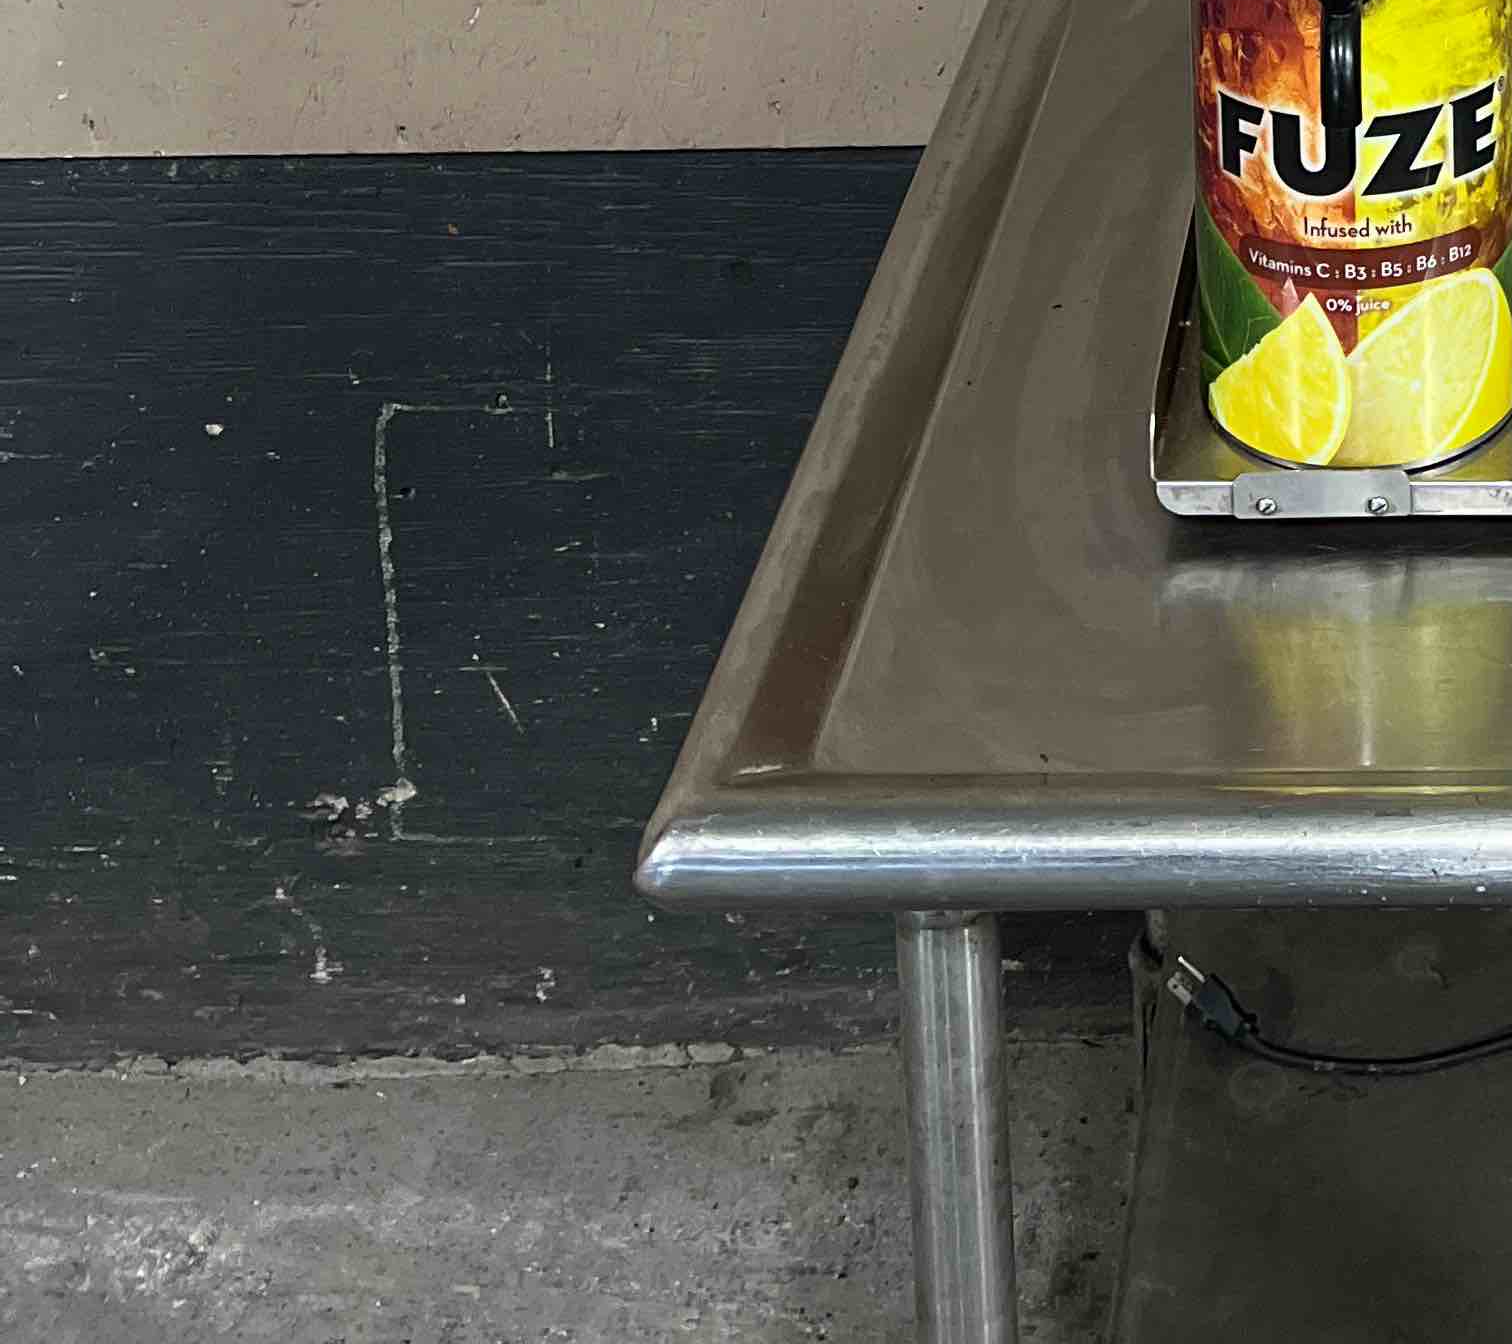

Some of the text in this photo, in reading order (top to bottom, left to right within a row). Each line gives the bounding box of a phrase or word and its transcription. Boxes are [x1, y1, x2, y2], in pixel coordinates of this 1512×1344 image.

[1218, 80, 1496, 197] FUZE
[1303, 216, 1412, 238] Infused with
[1249, 247, 1312, 278] Vitamins
[1316, 263, 1330, 279] C
[1344, 264, 1367, 281] B3
[1381, 261, 1403, 277] B5
[1416, 255, 1436, 271] B6
[1449, 244, 1472, 263] B12
[1326, 295, 1391, 316] 0% juice
